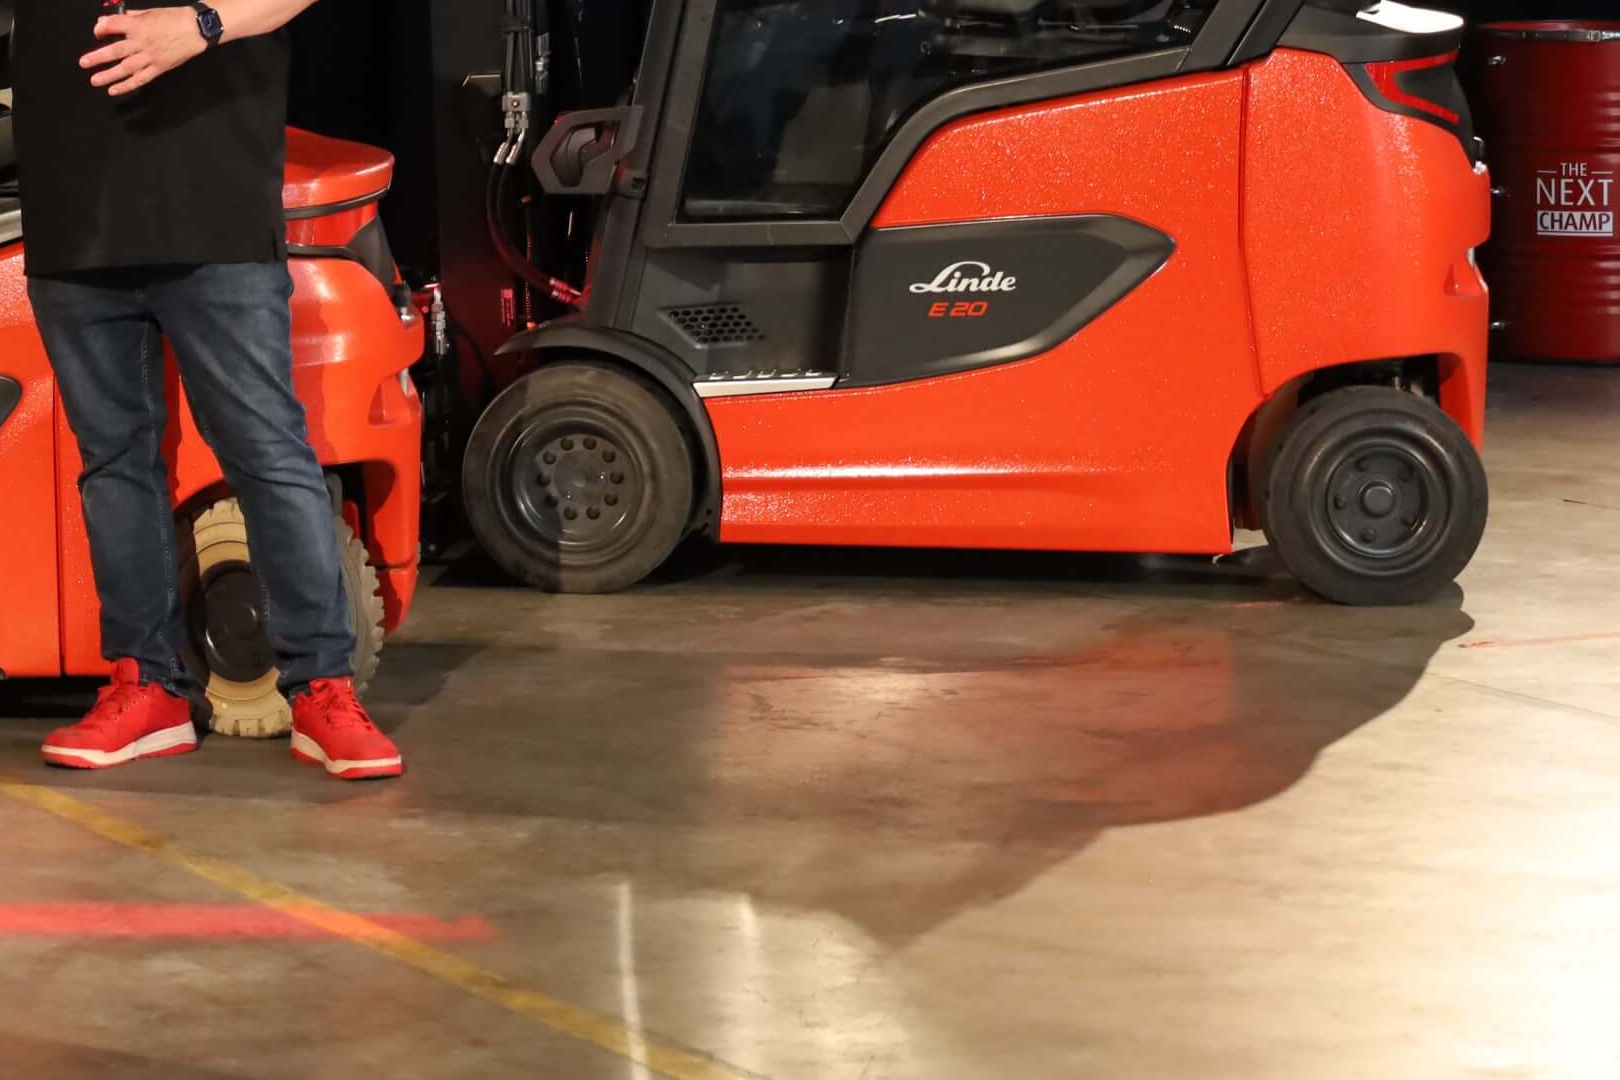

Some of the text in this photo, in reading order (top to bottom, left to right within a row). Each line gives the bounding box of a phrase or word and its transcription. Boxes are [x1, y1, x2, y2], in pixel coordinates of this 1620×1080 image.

[1560, 162, 1587, 176] THE
[1536, 178, 1613, 206] NEXT
[1539, 212, 1610, 230] CHAMP
[909, 261, 1016, 293] Linde
[928, 302, 988, 317] E 20
